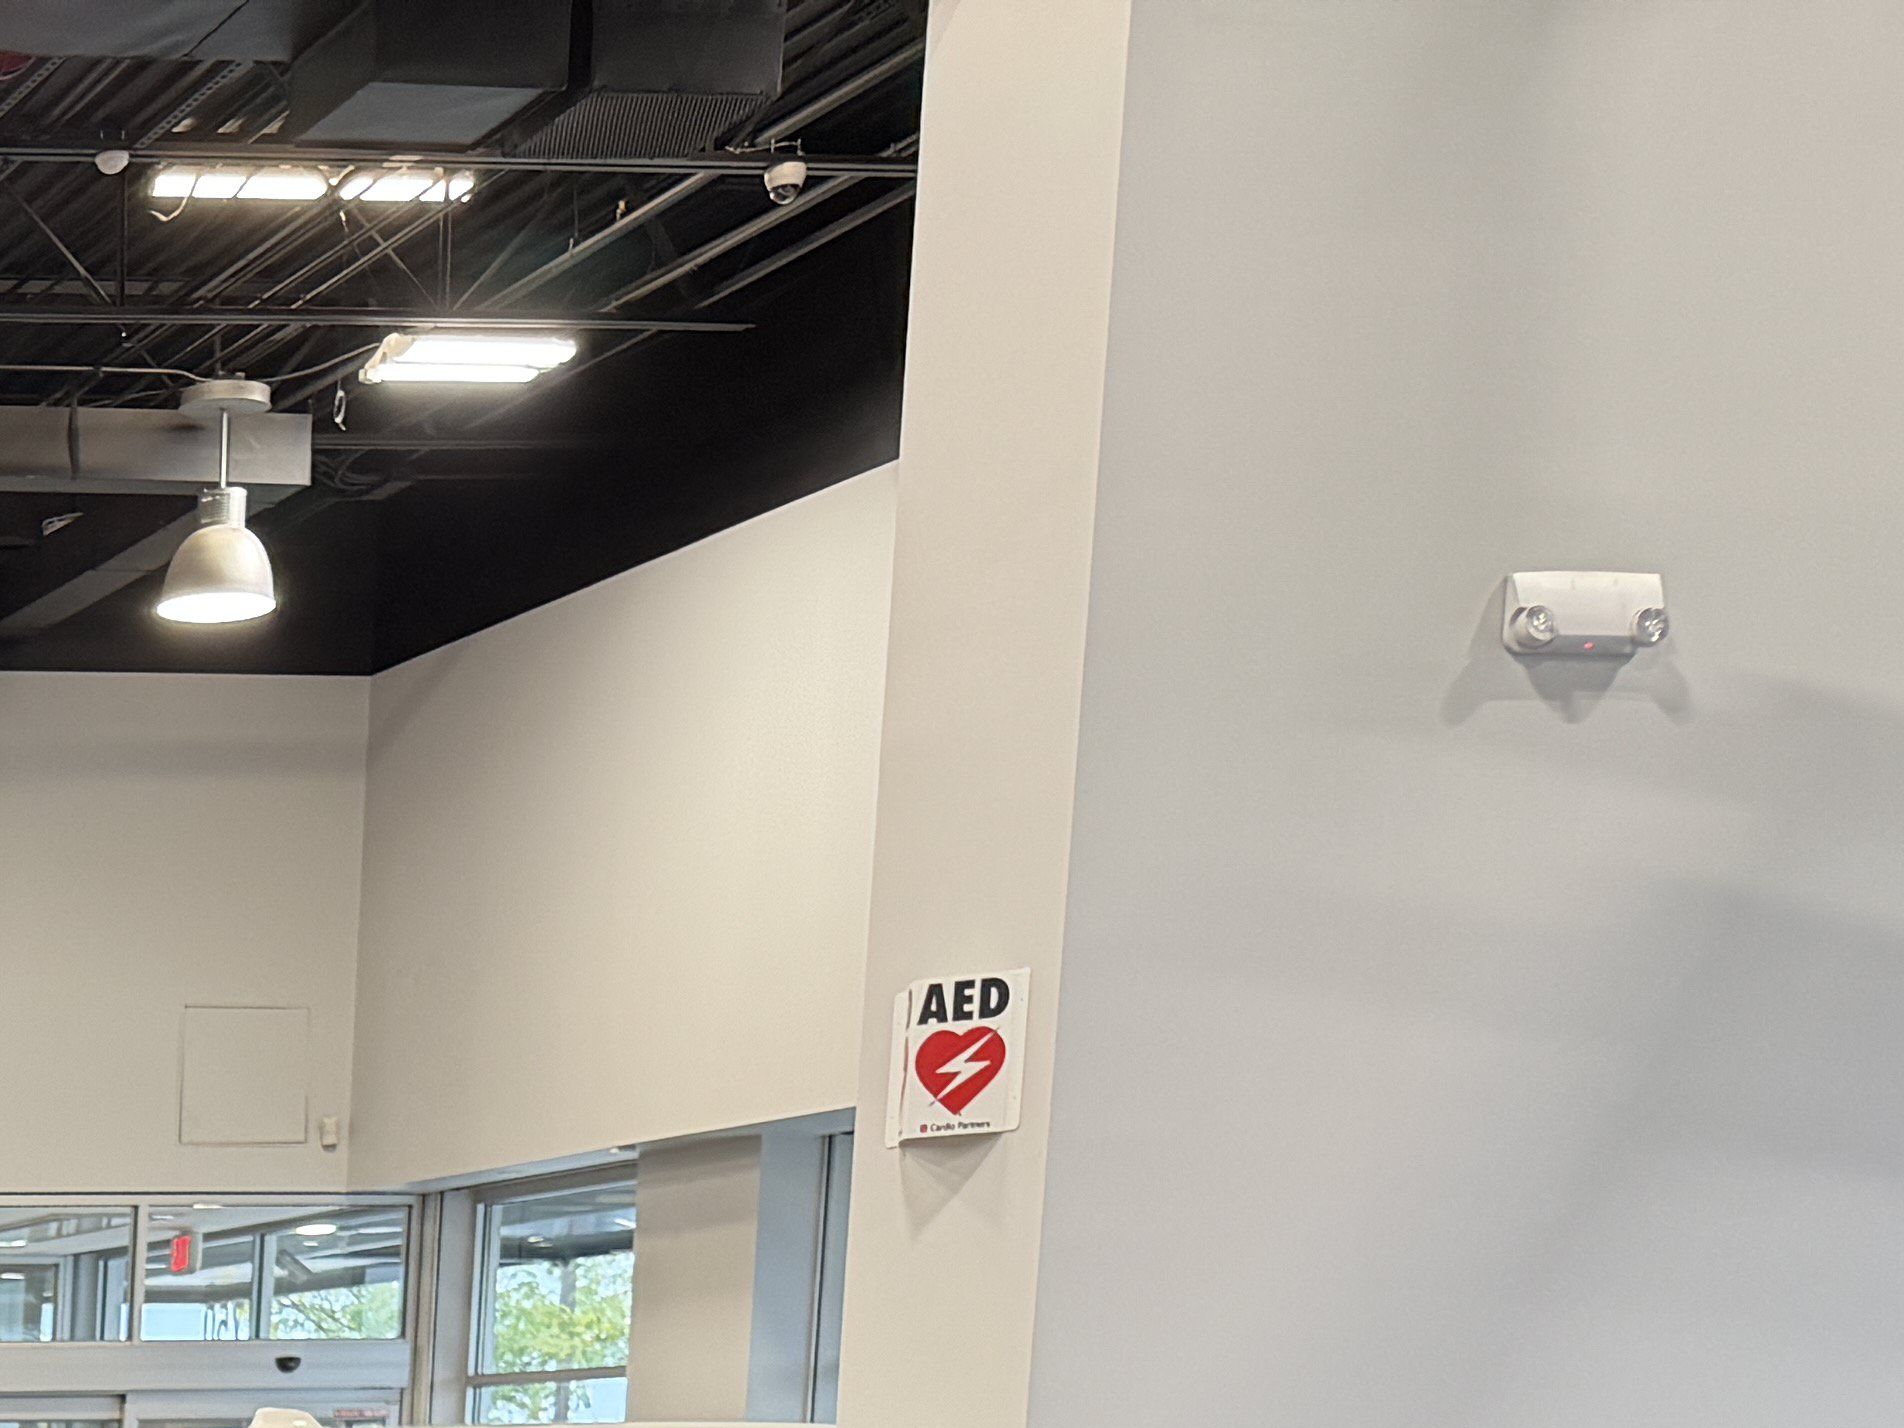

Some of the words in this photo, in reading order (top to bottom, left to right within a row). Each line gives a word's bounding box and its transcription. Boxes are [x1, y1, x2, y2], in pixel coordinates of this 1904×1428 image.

[917, 977, 1010, 1026] AED
[930, 1122, 955, 1132] Cardio
[957, 1121, 990, 1130] Partners
